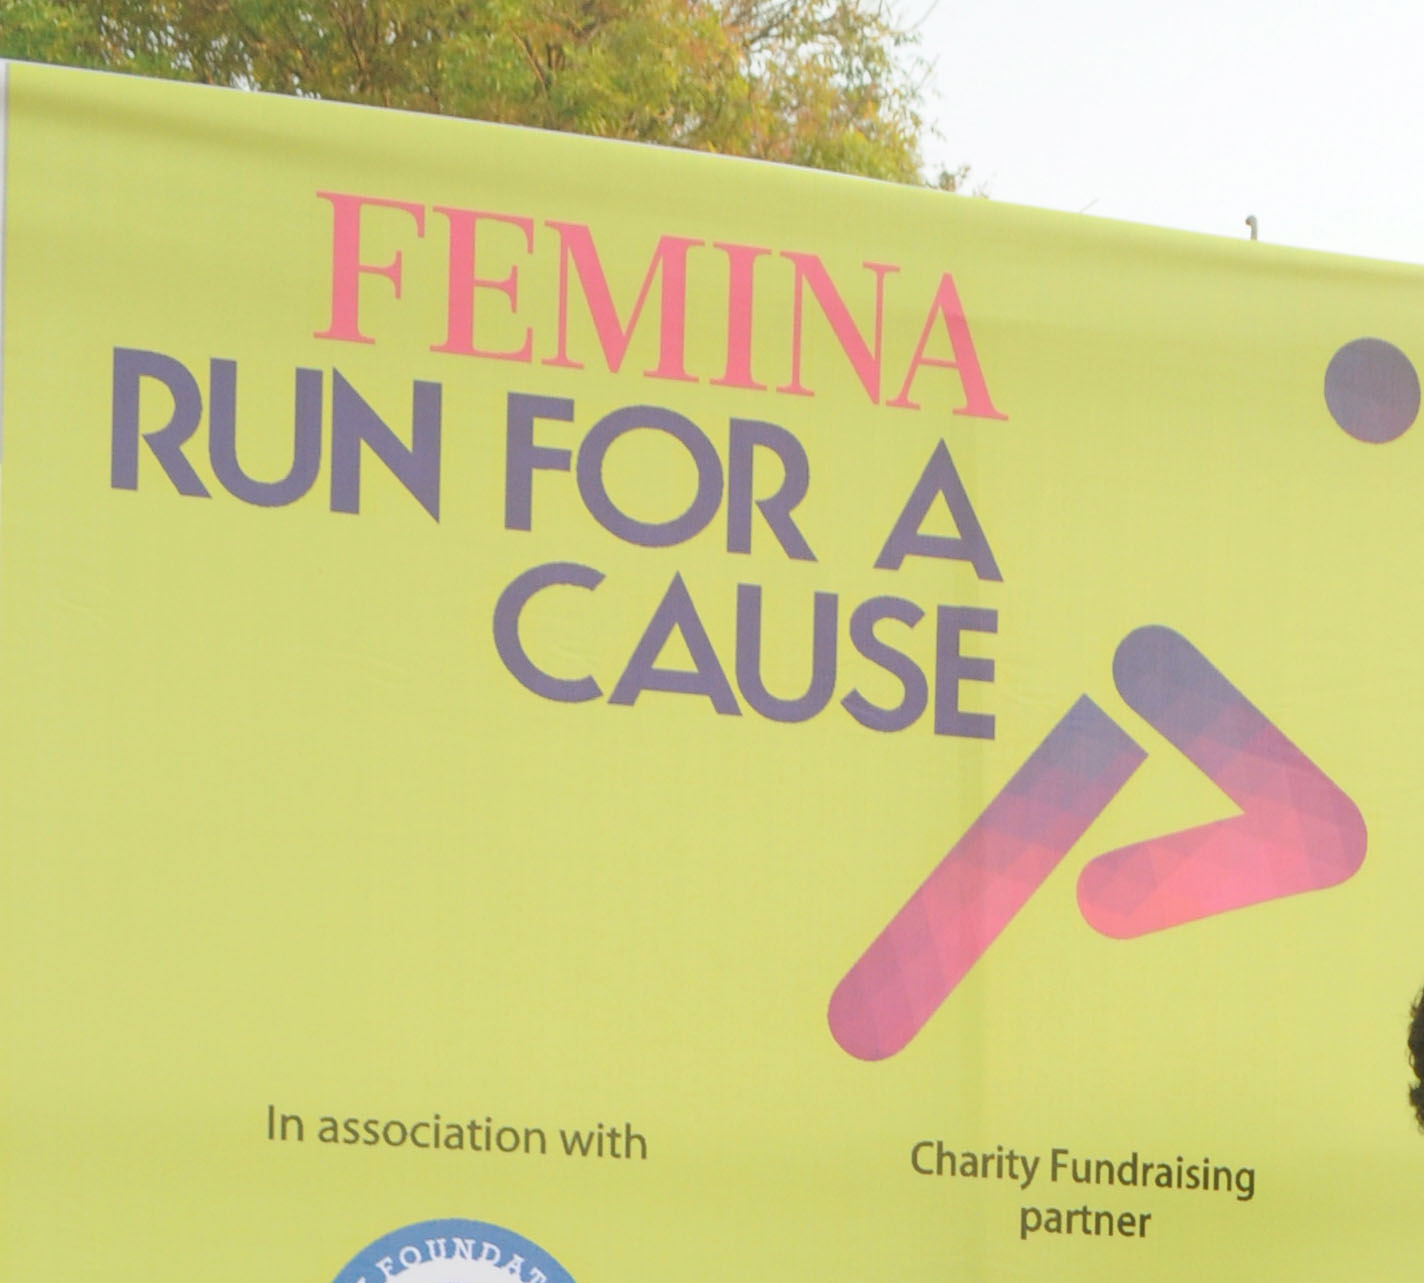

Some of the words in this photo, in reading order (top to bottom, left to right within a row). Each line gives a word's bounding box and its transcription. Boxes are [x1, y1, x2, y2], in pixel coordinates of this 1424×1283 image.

[313, 190, 1009, 421] FEMINA
[111, 346, 443, 524] RUN
[504, 391, 818, 562] FOR
[873, 438, 1004, 582] A
[492, 560, 999, 740] CAUSE
[267, 1105, 304, 1141] In
[318, 1114, 547, 1154] association
[561, 1122, 648, 1159] with
[911, 1140, 1040, 1190] Charity
[1050, 1149, 1256, 1201] Fundraising
[1020, 1204, 1151, 1240] partner
